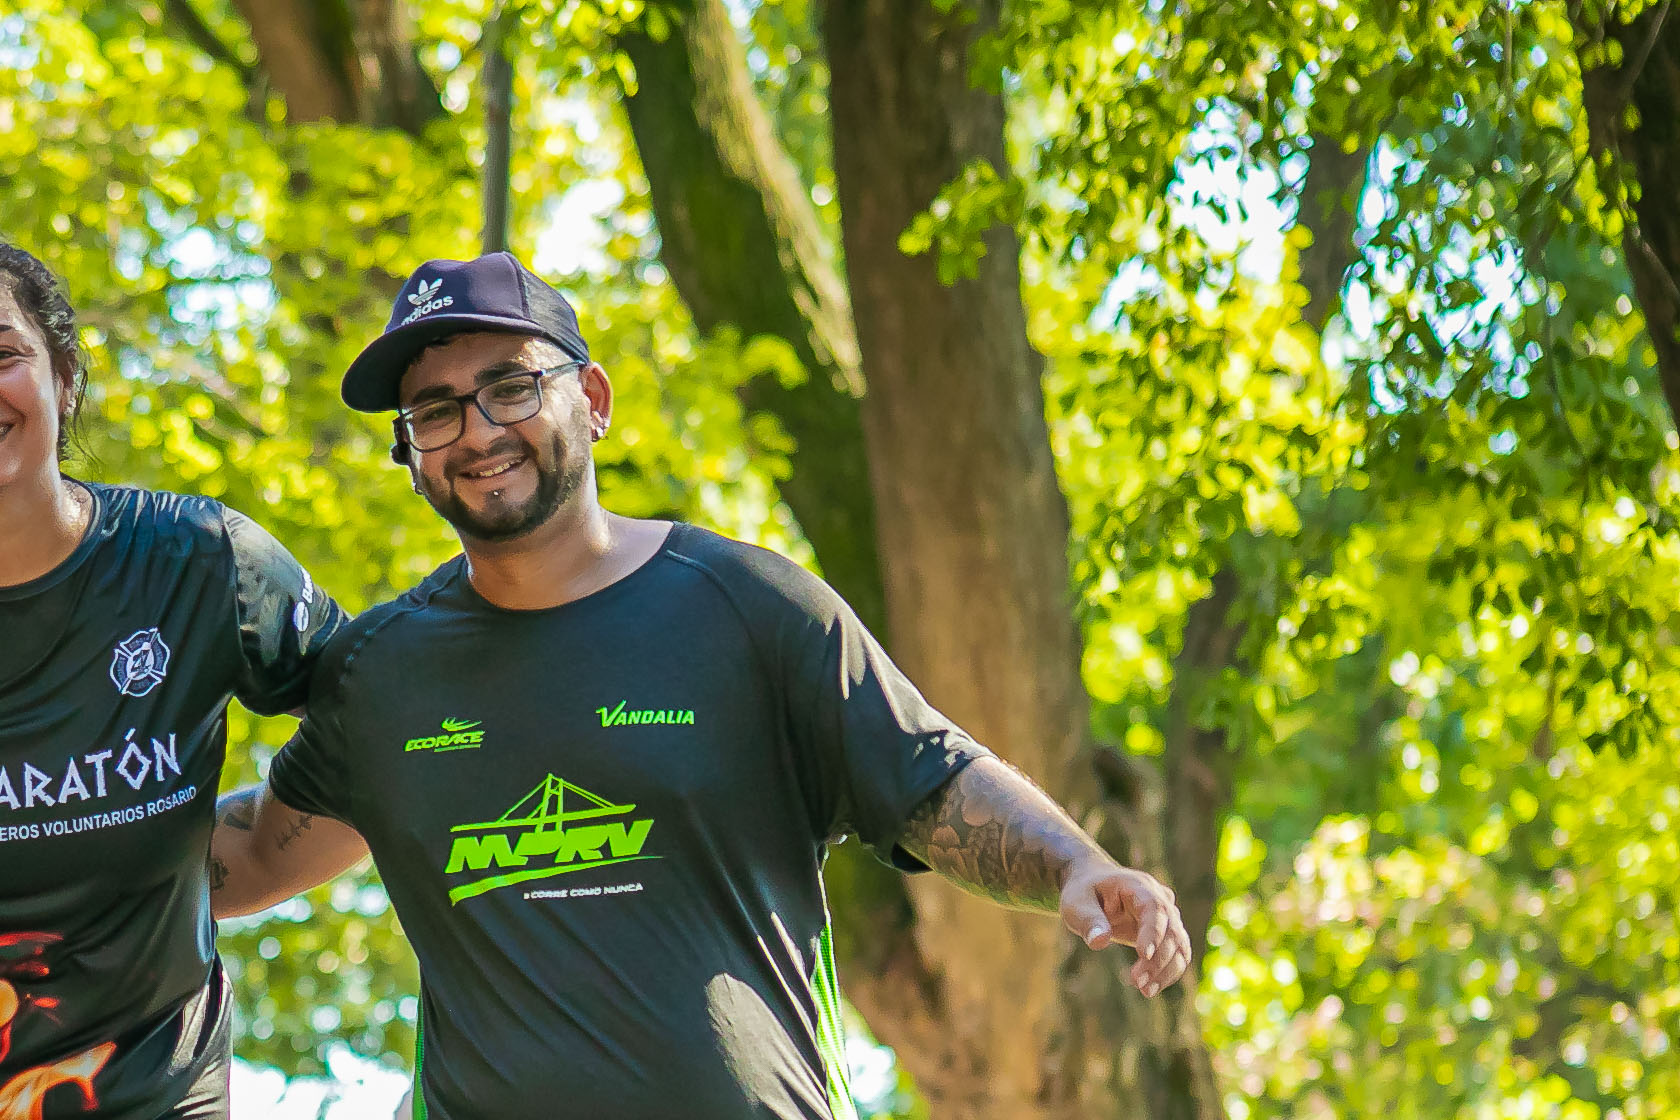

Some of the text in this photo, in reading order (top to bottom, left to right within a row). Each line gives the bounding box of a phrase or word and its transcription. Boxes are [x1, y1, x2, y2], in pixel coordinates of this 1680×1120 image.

[595, 700, 695, 727] VANDALIA
[405, 731, 486, 752] ECORACE
[42, 806, 145, 837] VOLUNTARIOS
[146, 786, 197, 817] ROSARIO
